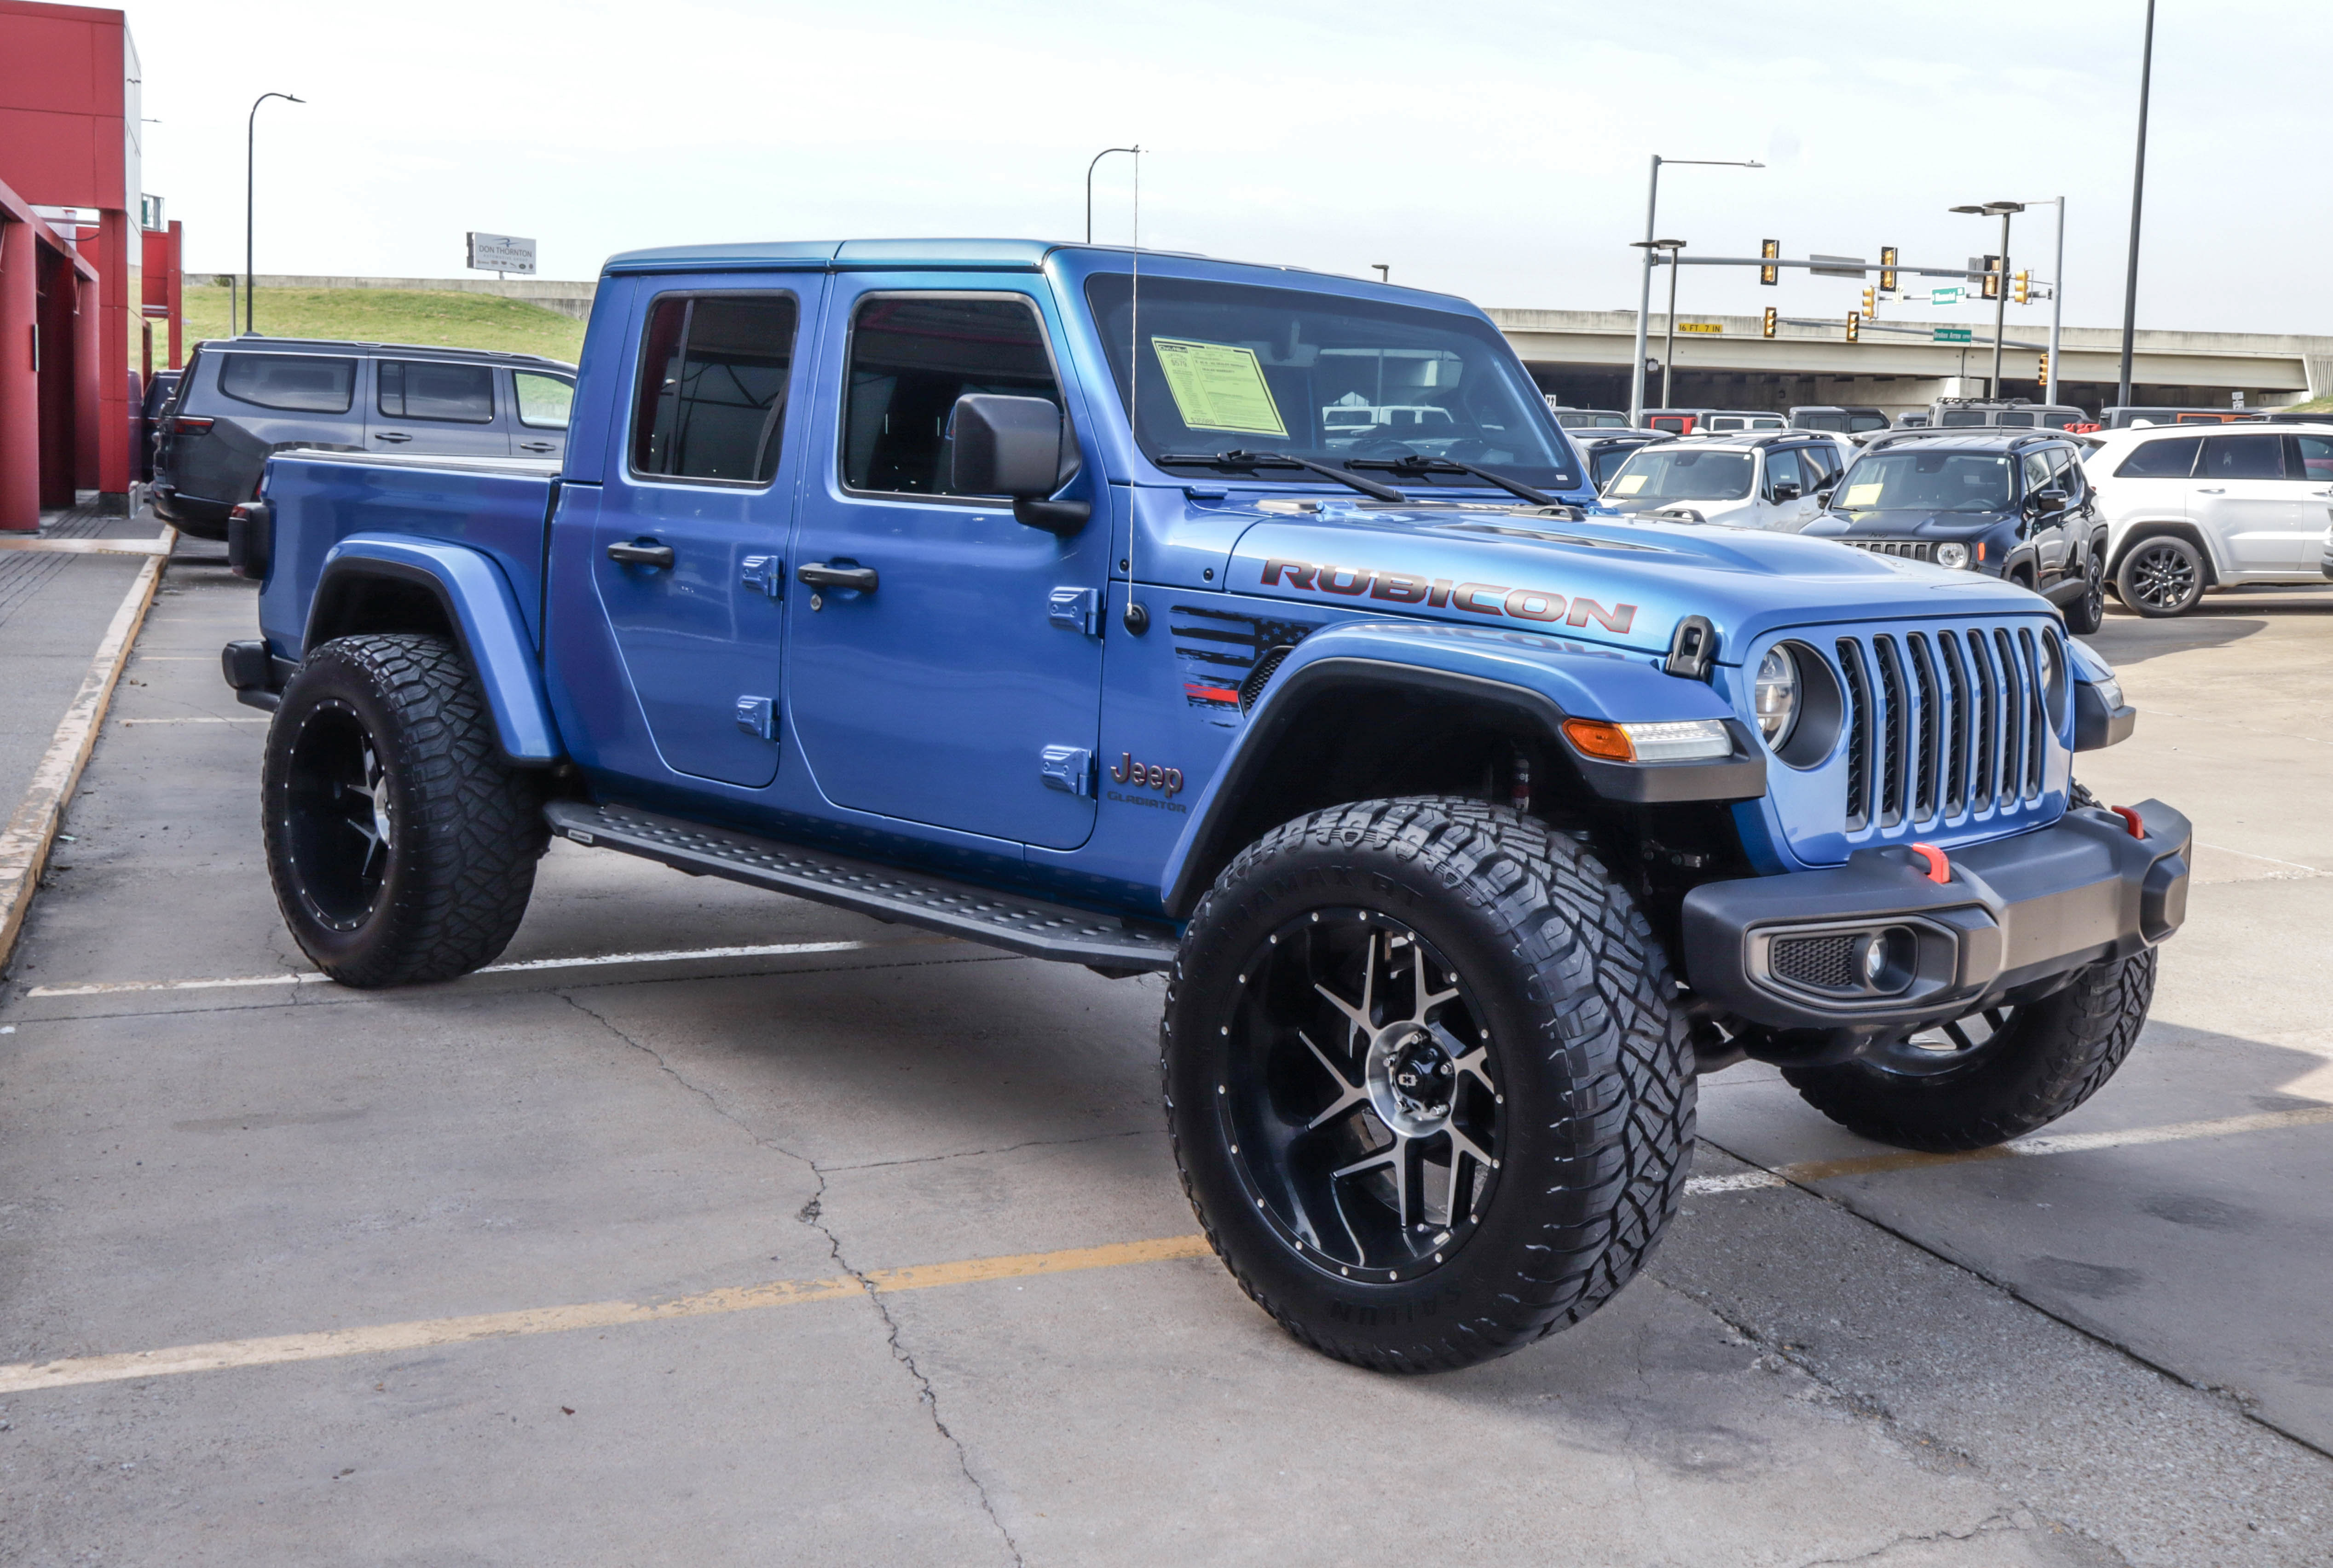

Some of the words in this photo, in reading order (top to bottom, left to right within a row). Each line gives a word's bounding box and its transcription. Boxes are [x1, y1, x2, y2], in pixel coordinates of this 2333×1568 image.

[479, 245, 495, 254] DON
[496, 247, 532, 258] THORNTON
[1260, 558, 1638, 634] RUBICON
[1110, 752, 1184, 799] Jeep
[1107, 790, 1187, 814] GLADIATOR
